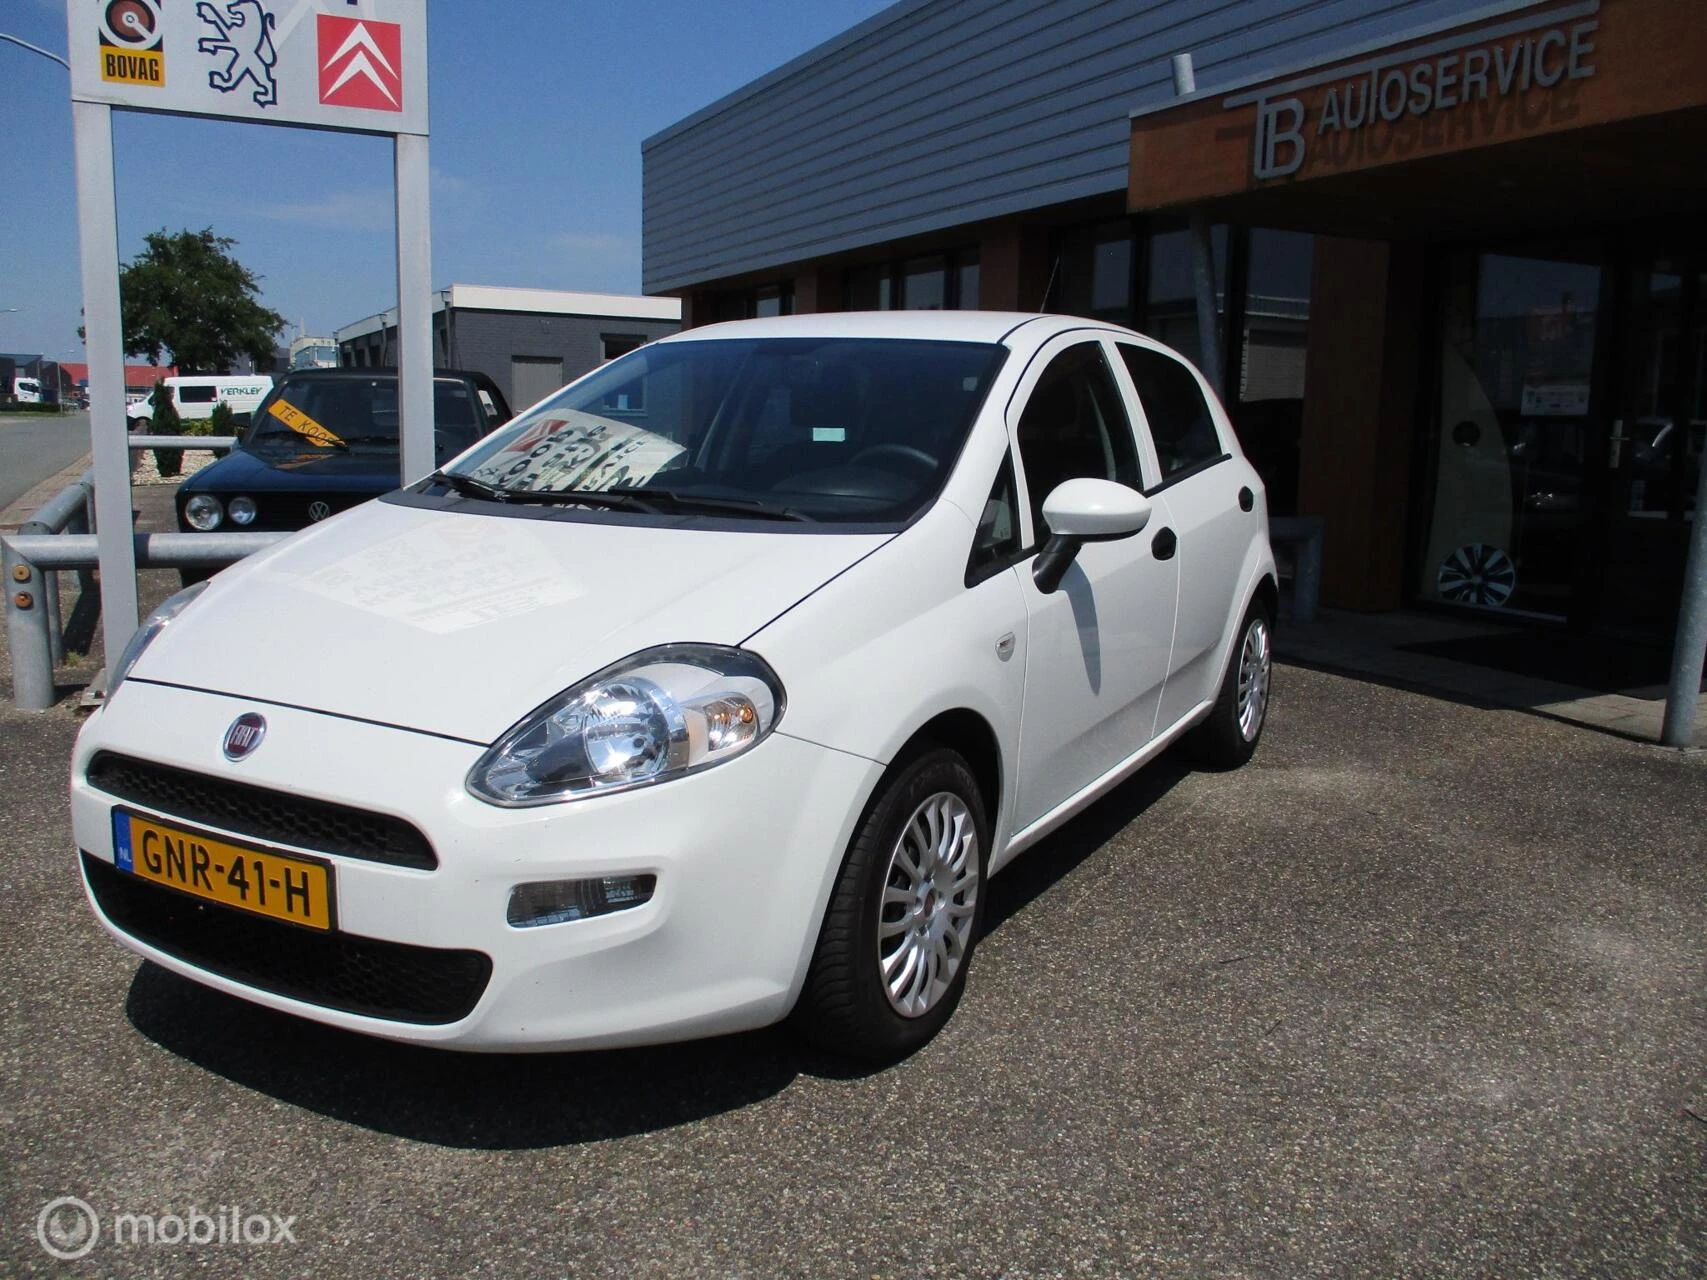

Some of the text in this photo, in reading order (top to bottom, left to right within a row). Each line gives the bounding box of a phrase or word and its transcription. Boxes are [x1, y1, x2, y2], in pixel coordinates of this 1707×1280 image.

[106, 53, 160, 82] BOVAG
[1317, 20, 1599, 135] AUTOSERVICE
[220, 386, 263, 396] VERKLEY
[280, 405, 298, 421] TE
[230, 724, 259, 748] FIAT
[119, 846, 132, 863] NL
[142, 829, 311, 918] GNR-41-H
